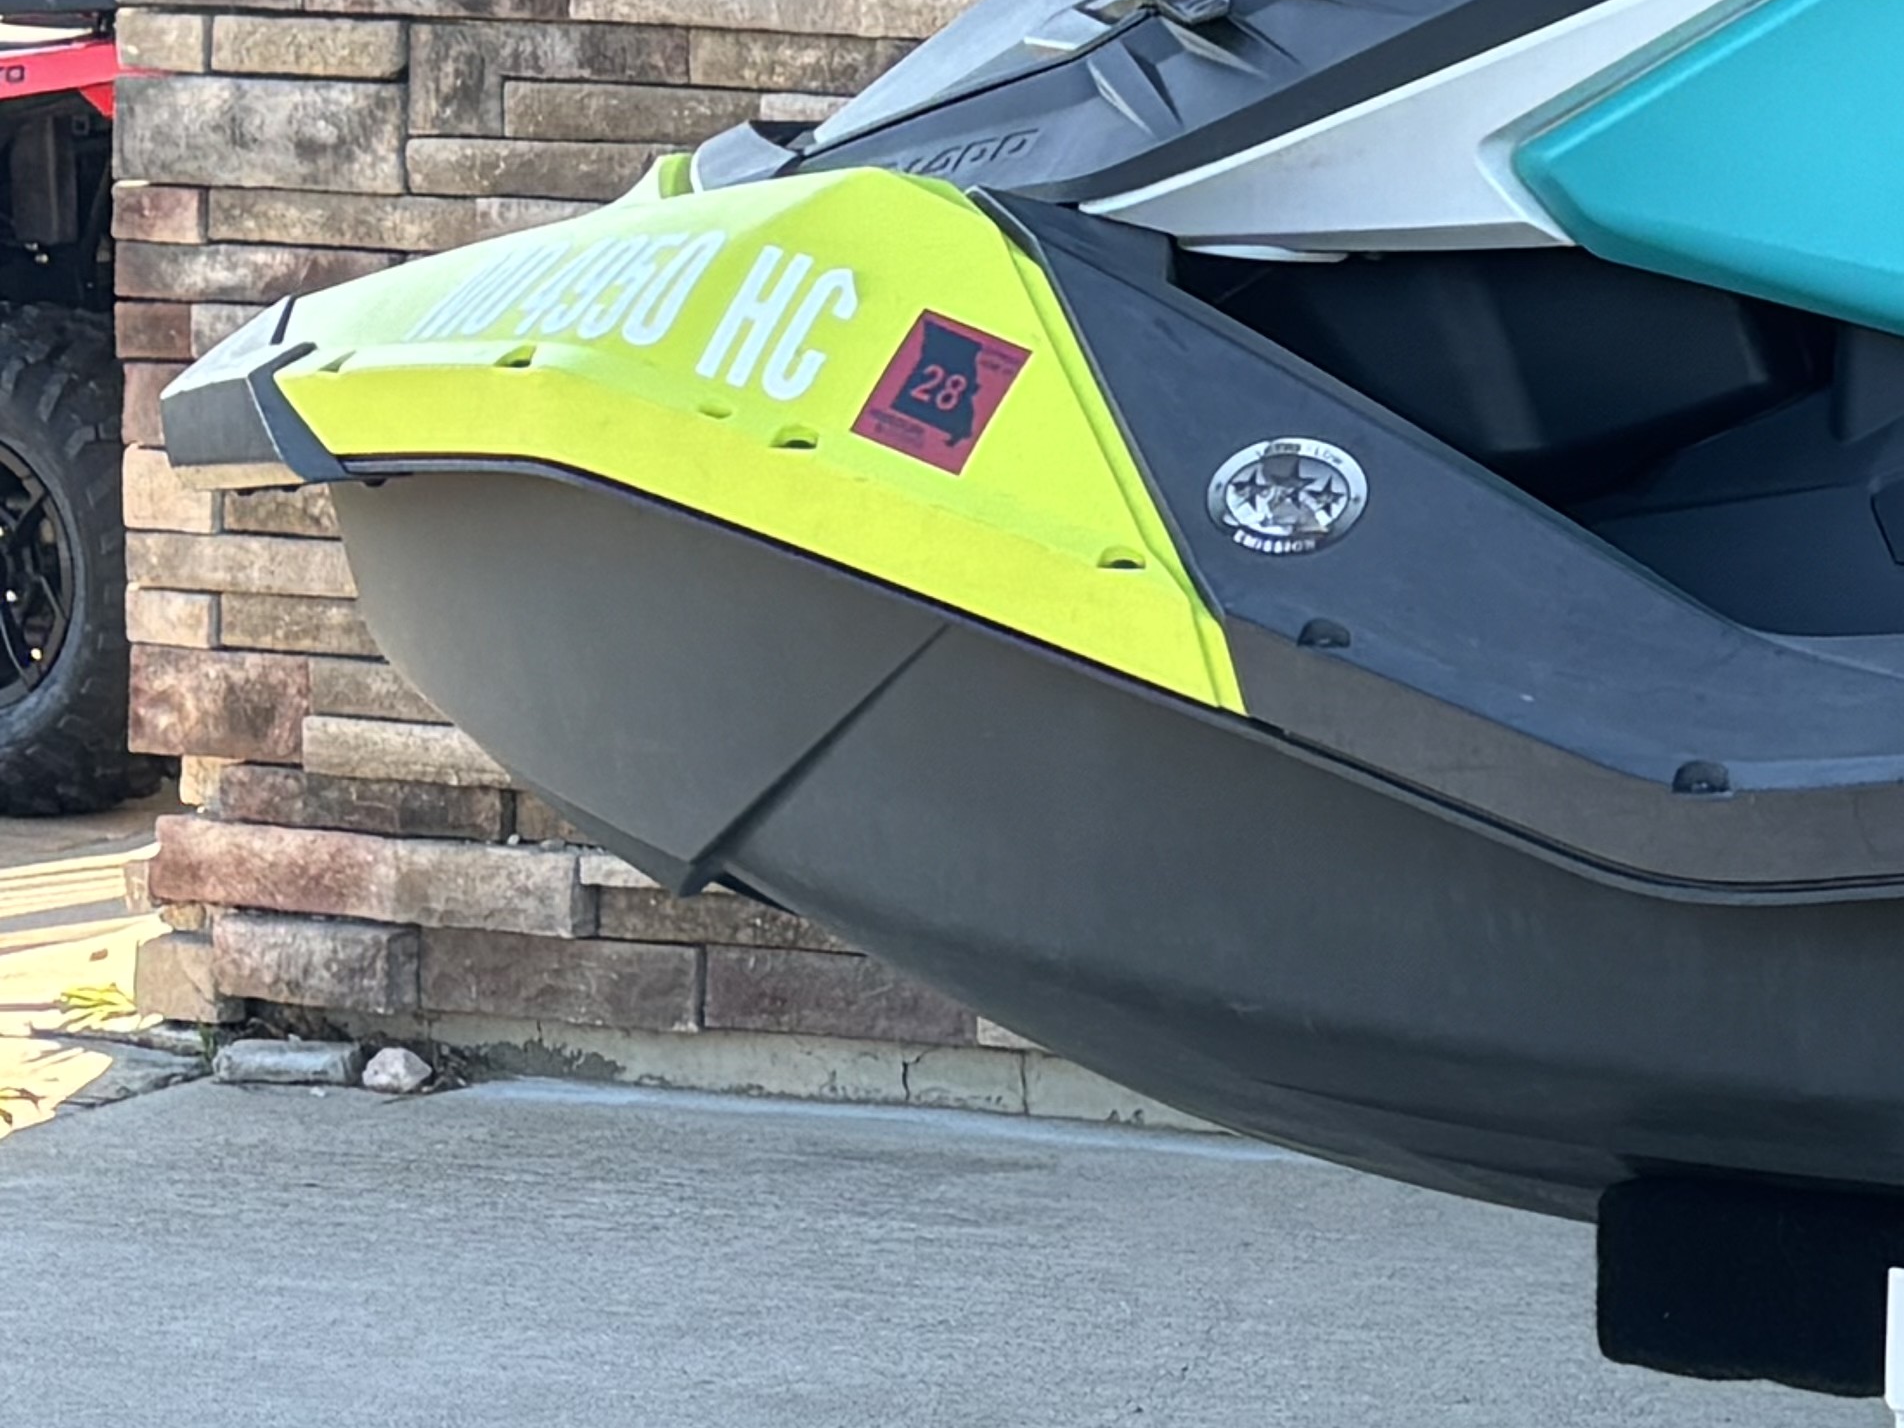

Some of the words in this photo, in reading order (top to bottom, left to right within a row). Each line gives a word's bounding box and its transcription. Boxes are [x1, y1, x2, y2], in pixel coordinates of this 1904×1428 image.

[514, 229, 727, 346] 4950
[695, 245, 859, 401] HC
[910, 364, 968, 411] 28
